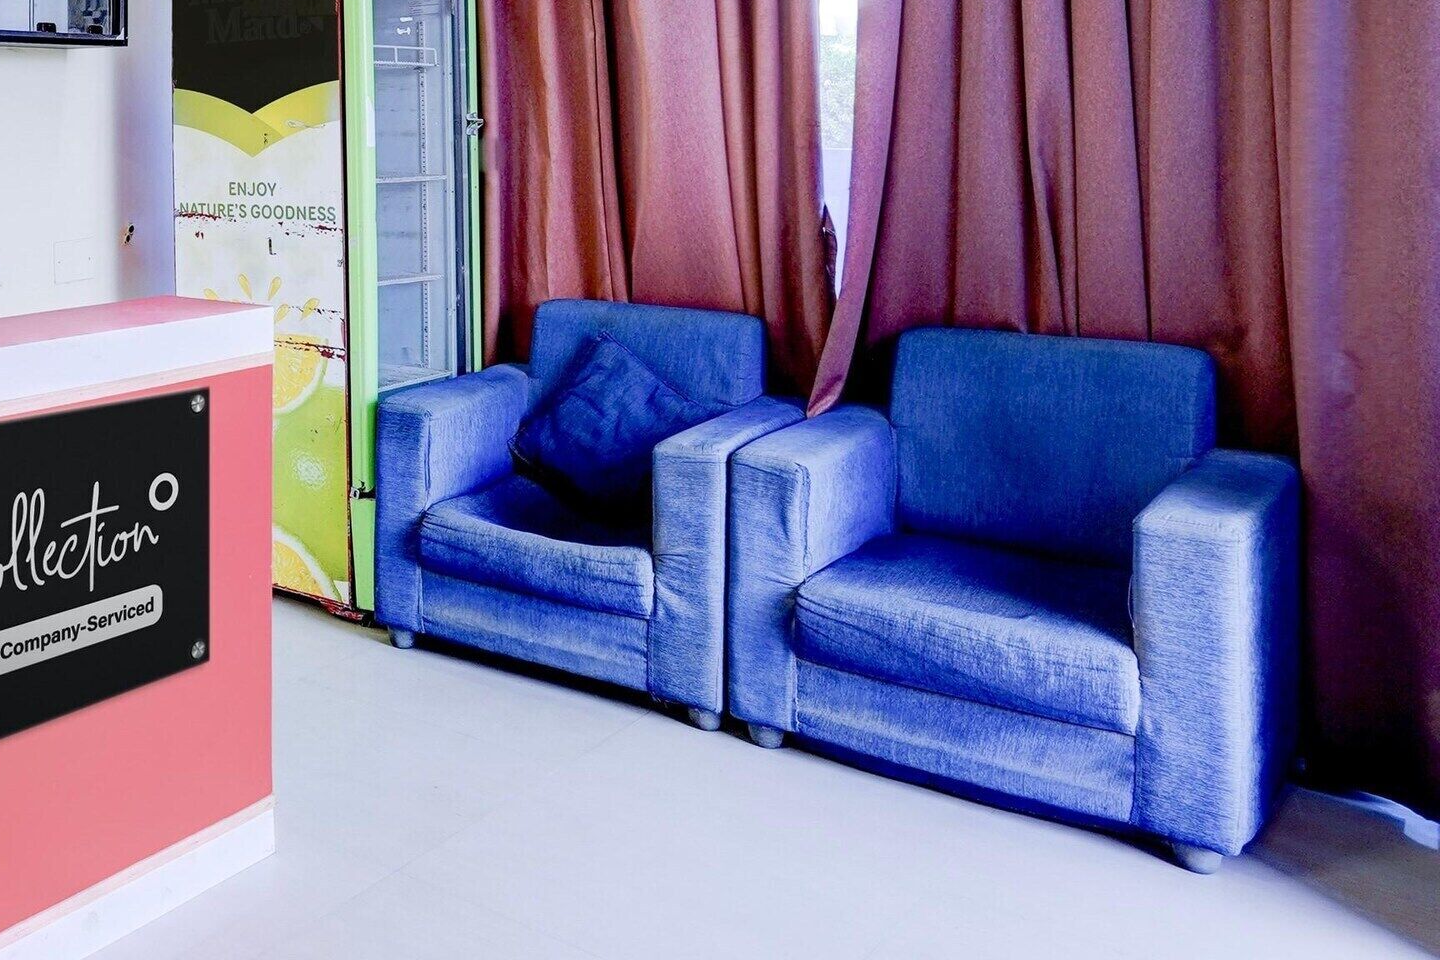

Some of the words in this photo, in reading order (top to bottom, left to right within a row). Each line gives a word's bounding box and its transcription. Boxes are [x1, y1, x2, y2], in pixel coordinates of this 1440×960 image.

[228, 181, 277, 197] ENJOY
[179, 202, 247, 219] NATURE'S
[250, 204, 336, 222] GOODNESS
[0, 596, 155, 660] Company-Serviced
